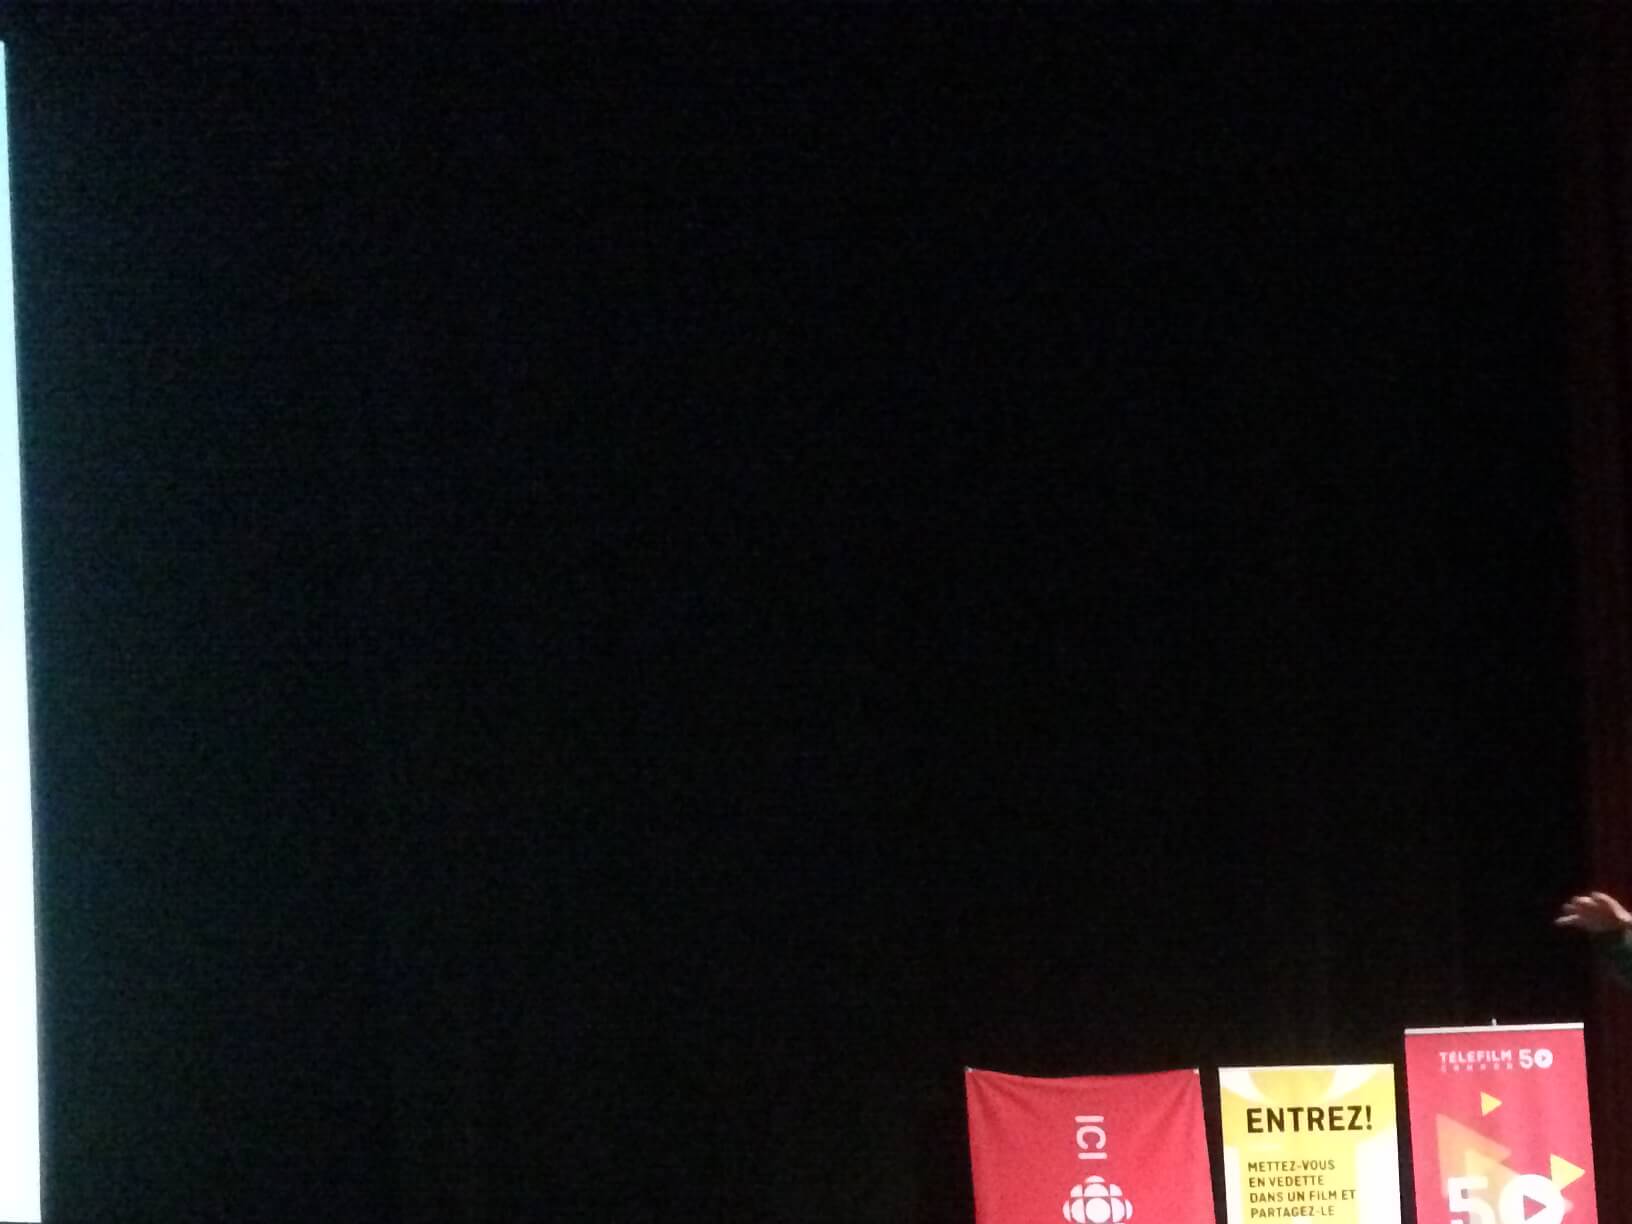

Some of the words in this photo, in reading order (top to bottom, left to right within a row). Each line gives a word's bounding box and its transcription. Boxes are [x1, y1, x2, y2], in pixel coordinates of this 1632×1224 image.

[1440, 1049, 1512, 1065] TELEFILM
[1246, 1105, 1373, 1133] ENTREZ!
[1074, 1115, 1108, 1160] ICI
[1248, 1159, 1336, 1172] METTEZ-VOUS
[1249, 1177, 1265, 1188] EN
[1268, 1175, 1325, 1187] VEDETTE
[1250, 1192, 1284, 1203] DANS
[1288, 1191, 1305, 1202] UN
[1309, 1189, 1338, 1201] FILM
[1341, 1189, 1356, 1200] ET
[1251, 1205, 1336, 1218] PARTAGEZ-LE
